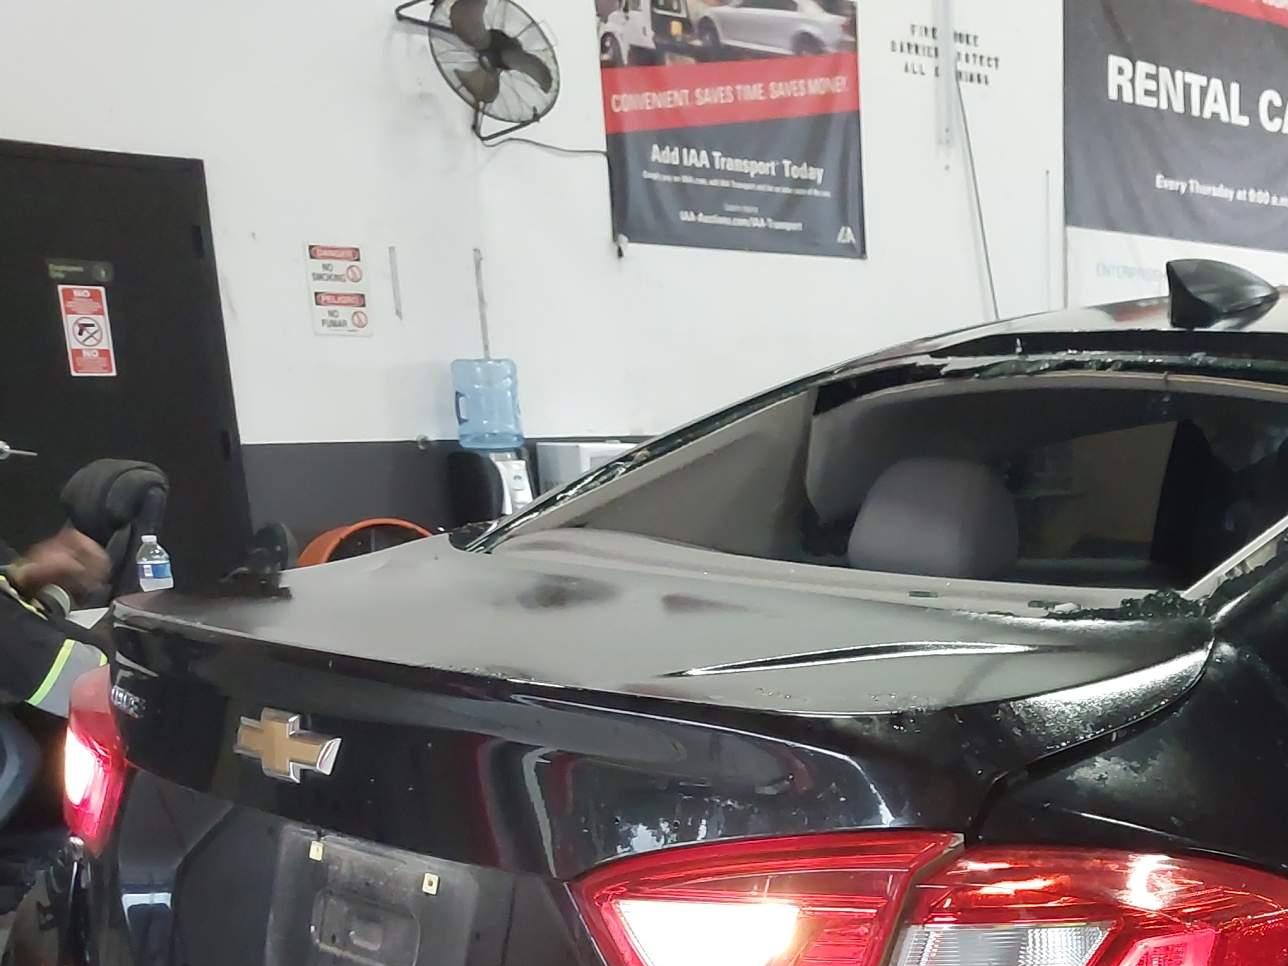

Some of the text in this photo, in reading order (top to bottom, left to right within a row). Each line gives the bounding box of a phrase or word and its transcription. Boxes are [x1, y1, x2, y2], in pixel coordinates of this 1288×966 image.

[904, 61, 926, 76] ALL
[694, 87, 735, 106] SAVES
[768, 79, 806, 101] SAVES
[1107, 54, 1249, 127] RENTAL
[651, 143, 679, 166] Add
[682, 147, 711, 169] IAA
[782, 159, 824, 185] Today
[1155, 173, 1188, 195] Every
[1189, 178, 1235, 202] Thursday
[1235, 188, 1247, 202] at
[72, 289, 91, 298] NO
[81, 349, 100, 358] NO
